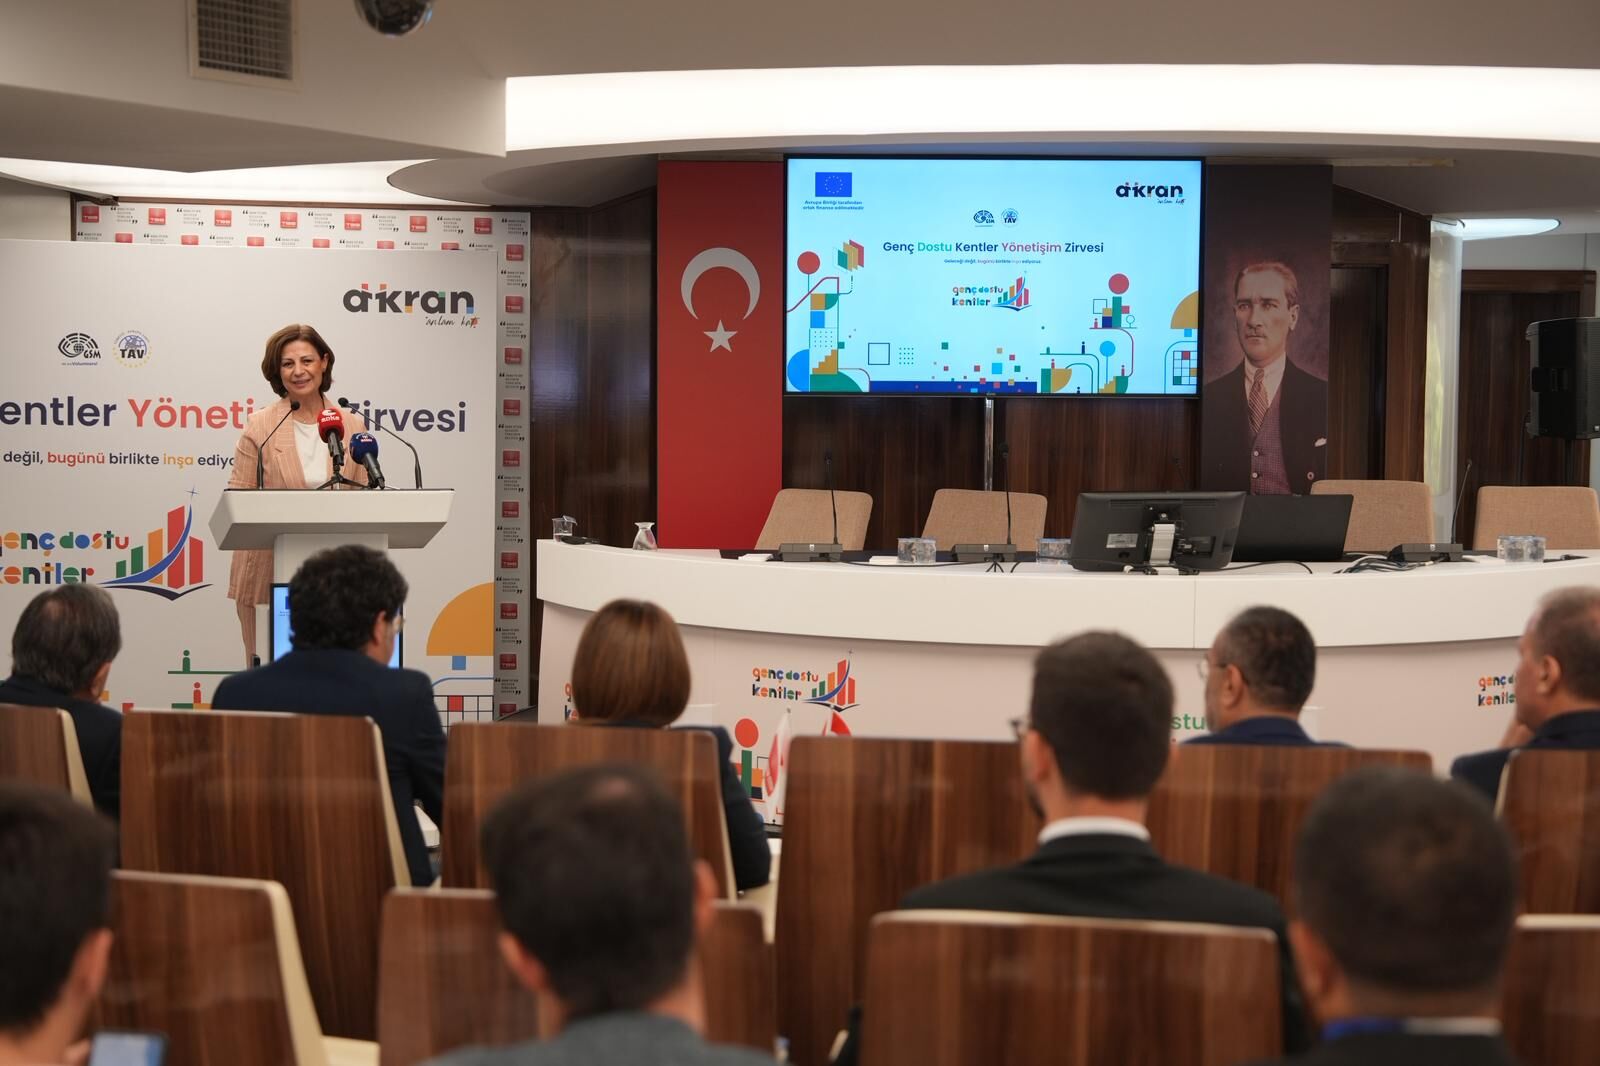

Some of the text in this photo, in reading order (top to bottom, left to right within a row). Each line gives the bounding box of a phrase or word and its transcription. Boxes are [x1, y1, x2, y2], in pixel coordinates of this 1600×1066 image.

[882, 241, 1104, 255] Genç Dostu Kentler Yönetişim Zirvesi
[343, 283, 474, 314] akran
[952, 285, 1004, 296] genç dostu
[951, 297, 991, 307] kentler
[83, 349, 102, 359] GSM
[119, 348, 145, 359] TAV
[127, 397, 254, 430] Yöneti
[3, 451, 235, 469] değil, bugünü birlikte inşa ediyo
[0, 531, 129, 557] enç dostu
[0, 562, 94, 584] entler
[752, 667, 819, 684] genç dostu
[1478, 675, 1506, 692] genç
[752, 684, 802, 701] kentler
[1478, 691, 1516, 707] kentle
[1171, 713, 1205, 730] stu
